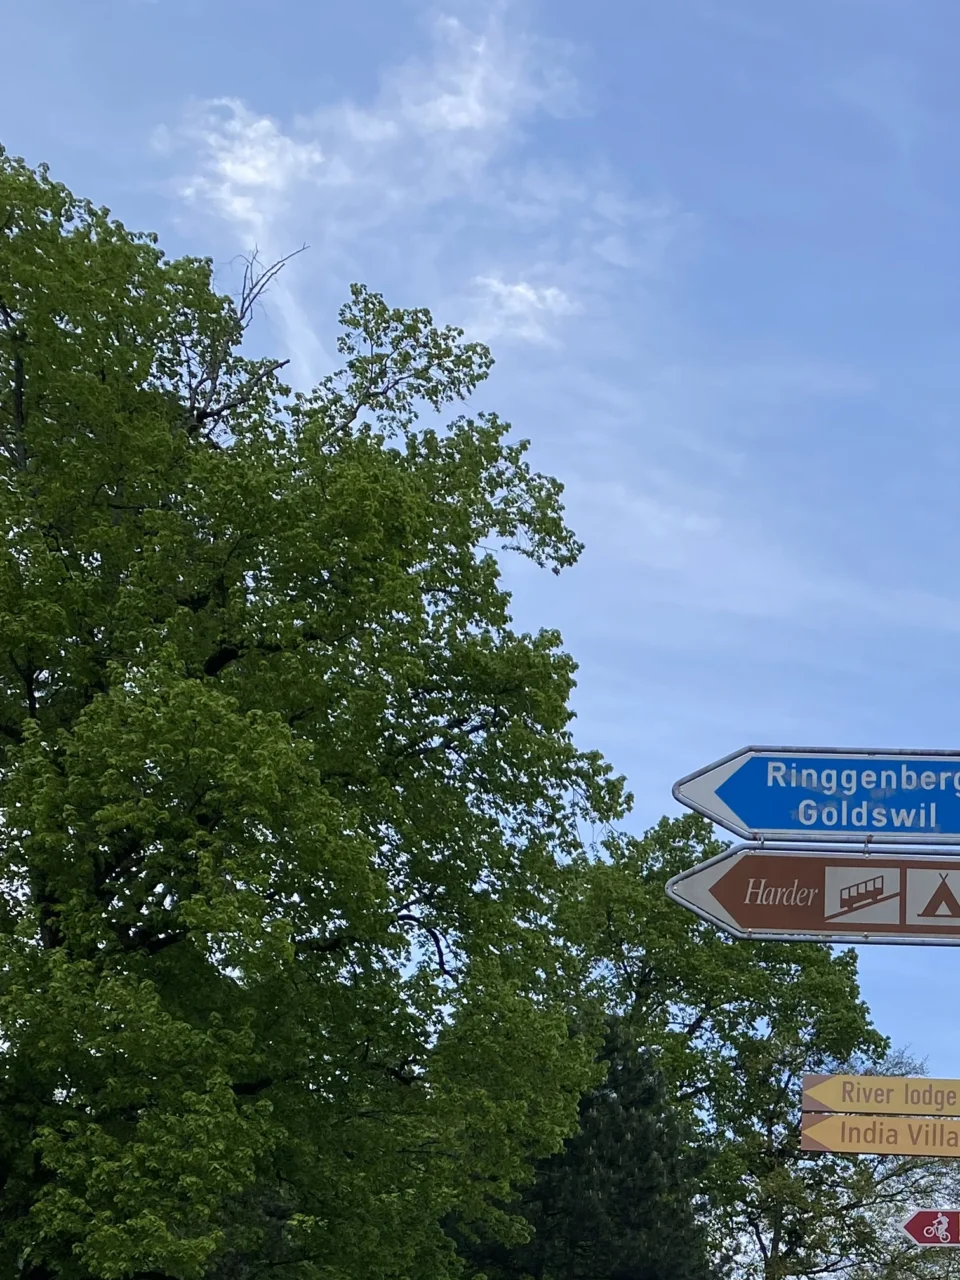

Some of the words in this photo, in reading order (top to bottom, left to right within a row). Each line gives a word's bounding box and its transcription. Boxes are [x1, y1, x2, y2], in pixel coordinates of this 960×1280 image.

[798, 799, 937, 829] Goldswil
[743, 878, 819, 907] Harder
[841, 1081, 895, 1106] River
[903, 1083, 957, 1110] lodge
[840, 1121, 898, 1145] India
